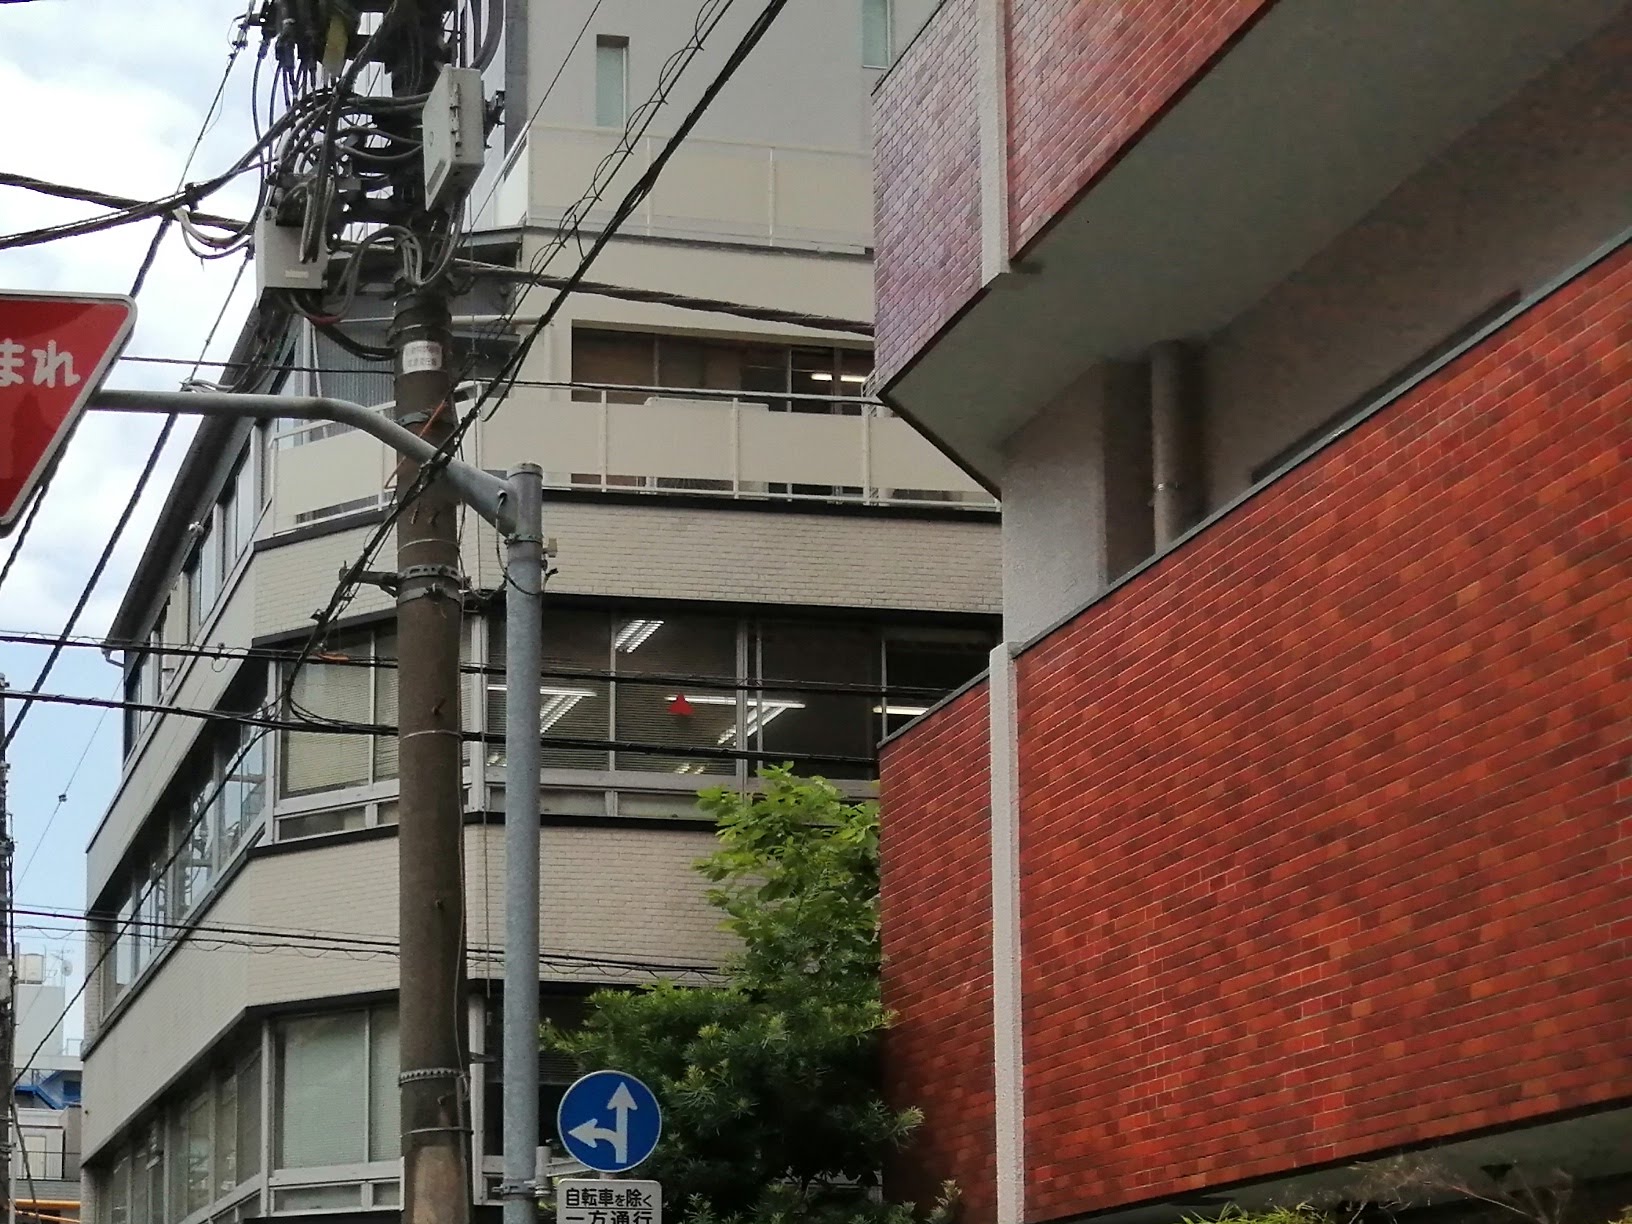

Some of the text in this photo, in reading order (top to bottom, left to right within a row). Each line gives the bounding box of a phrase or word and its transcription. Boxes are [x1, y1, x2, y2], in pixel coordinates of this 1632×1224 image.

[566, 1188, 653, 1208] 自転車を除く
